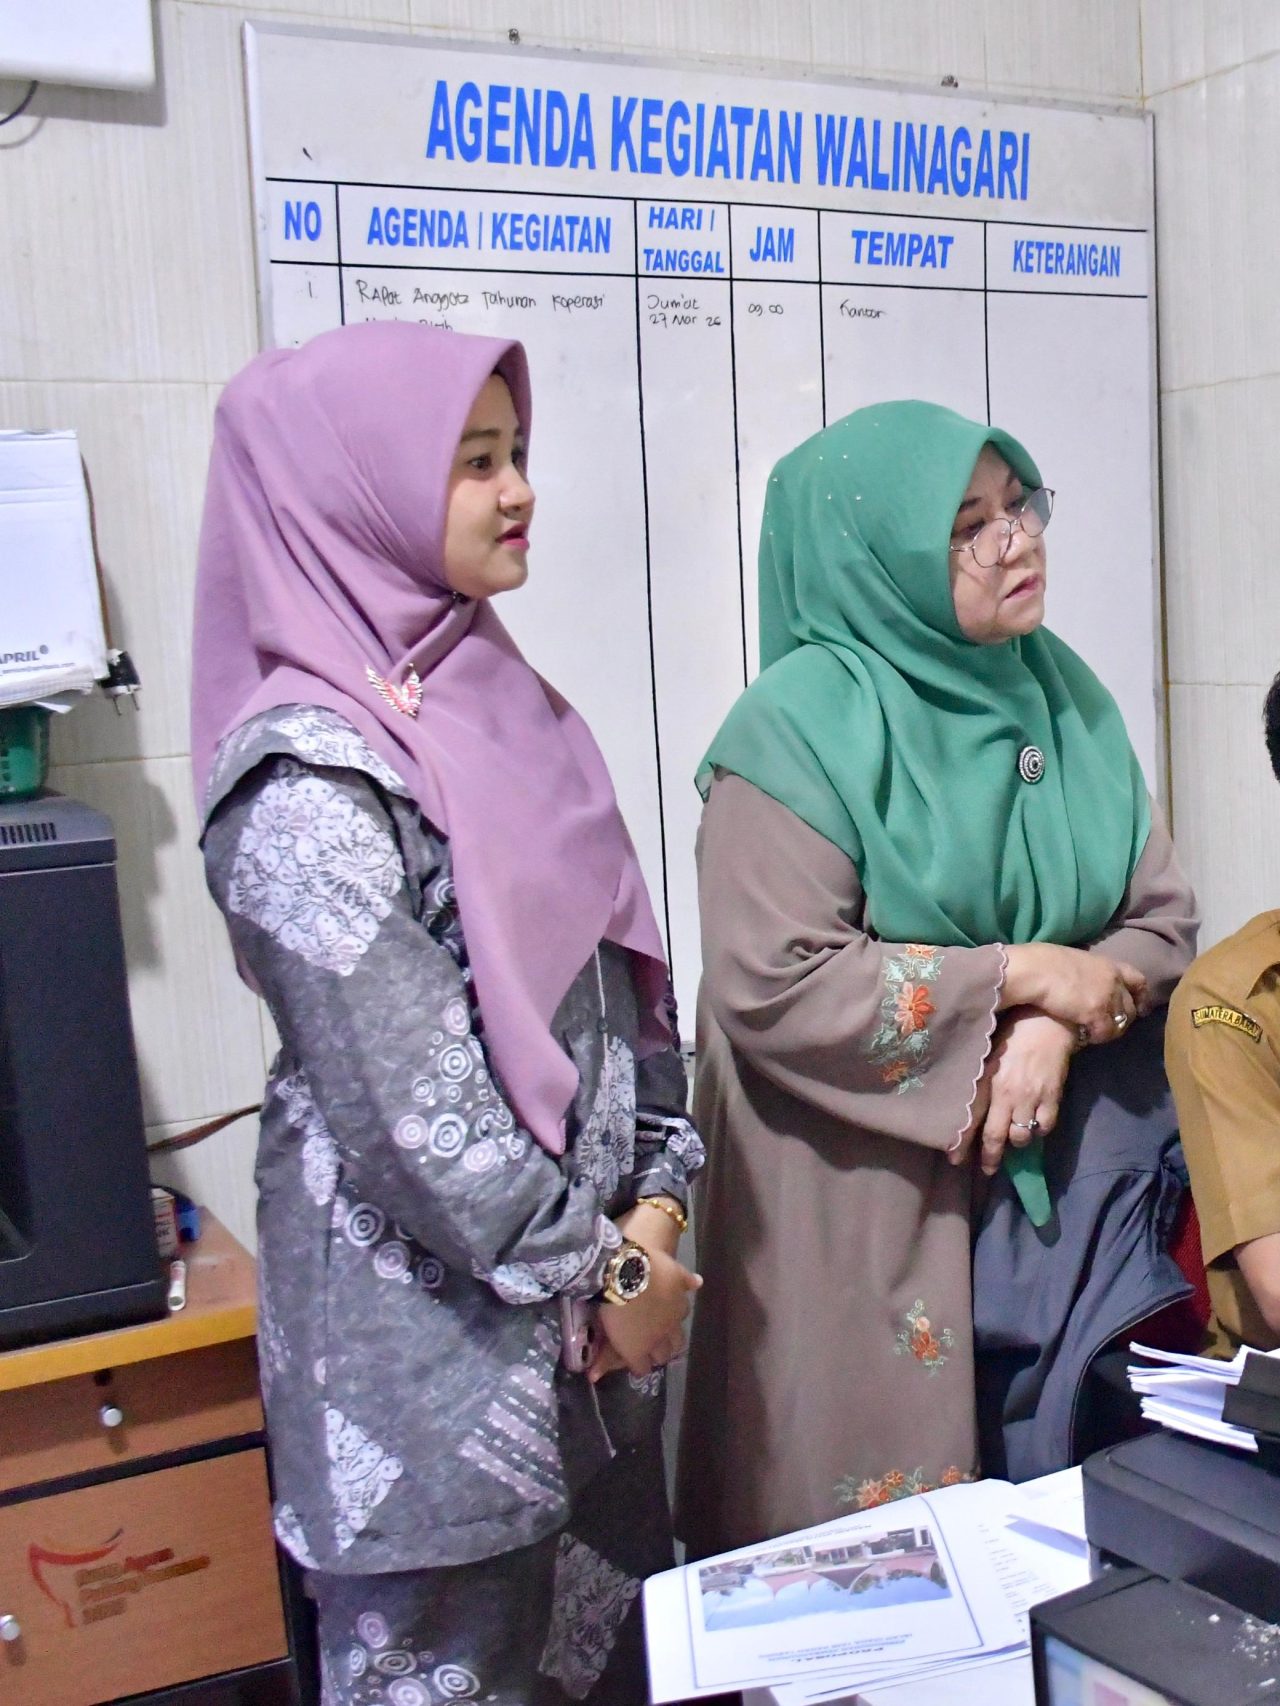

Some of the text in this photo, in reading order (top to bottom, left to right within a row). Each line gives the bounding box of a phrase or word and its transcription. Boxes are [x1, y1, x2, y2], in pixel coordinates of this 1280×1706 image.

[425, 79, 1031, 201] AGENDA KEGIATAN WALINAGARI
[283, 199, 323, 242] NO
[366, 206, 470, 249] AGENDA
[490, 211, 612, 254] KEGIATAN
[647, 206, 704, 231] HARI
[643, 248, 726, 274] TANGGAL
[749, 226, 796, 263] JAM
[851, 229, 955, 270] TEMPAT
[1012, 239, 1121, 278] KETERANGAN
